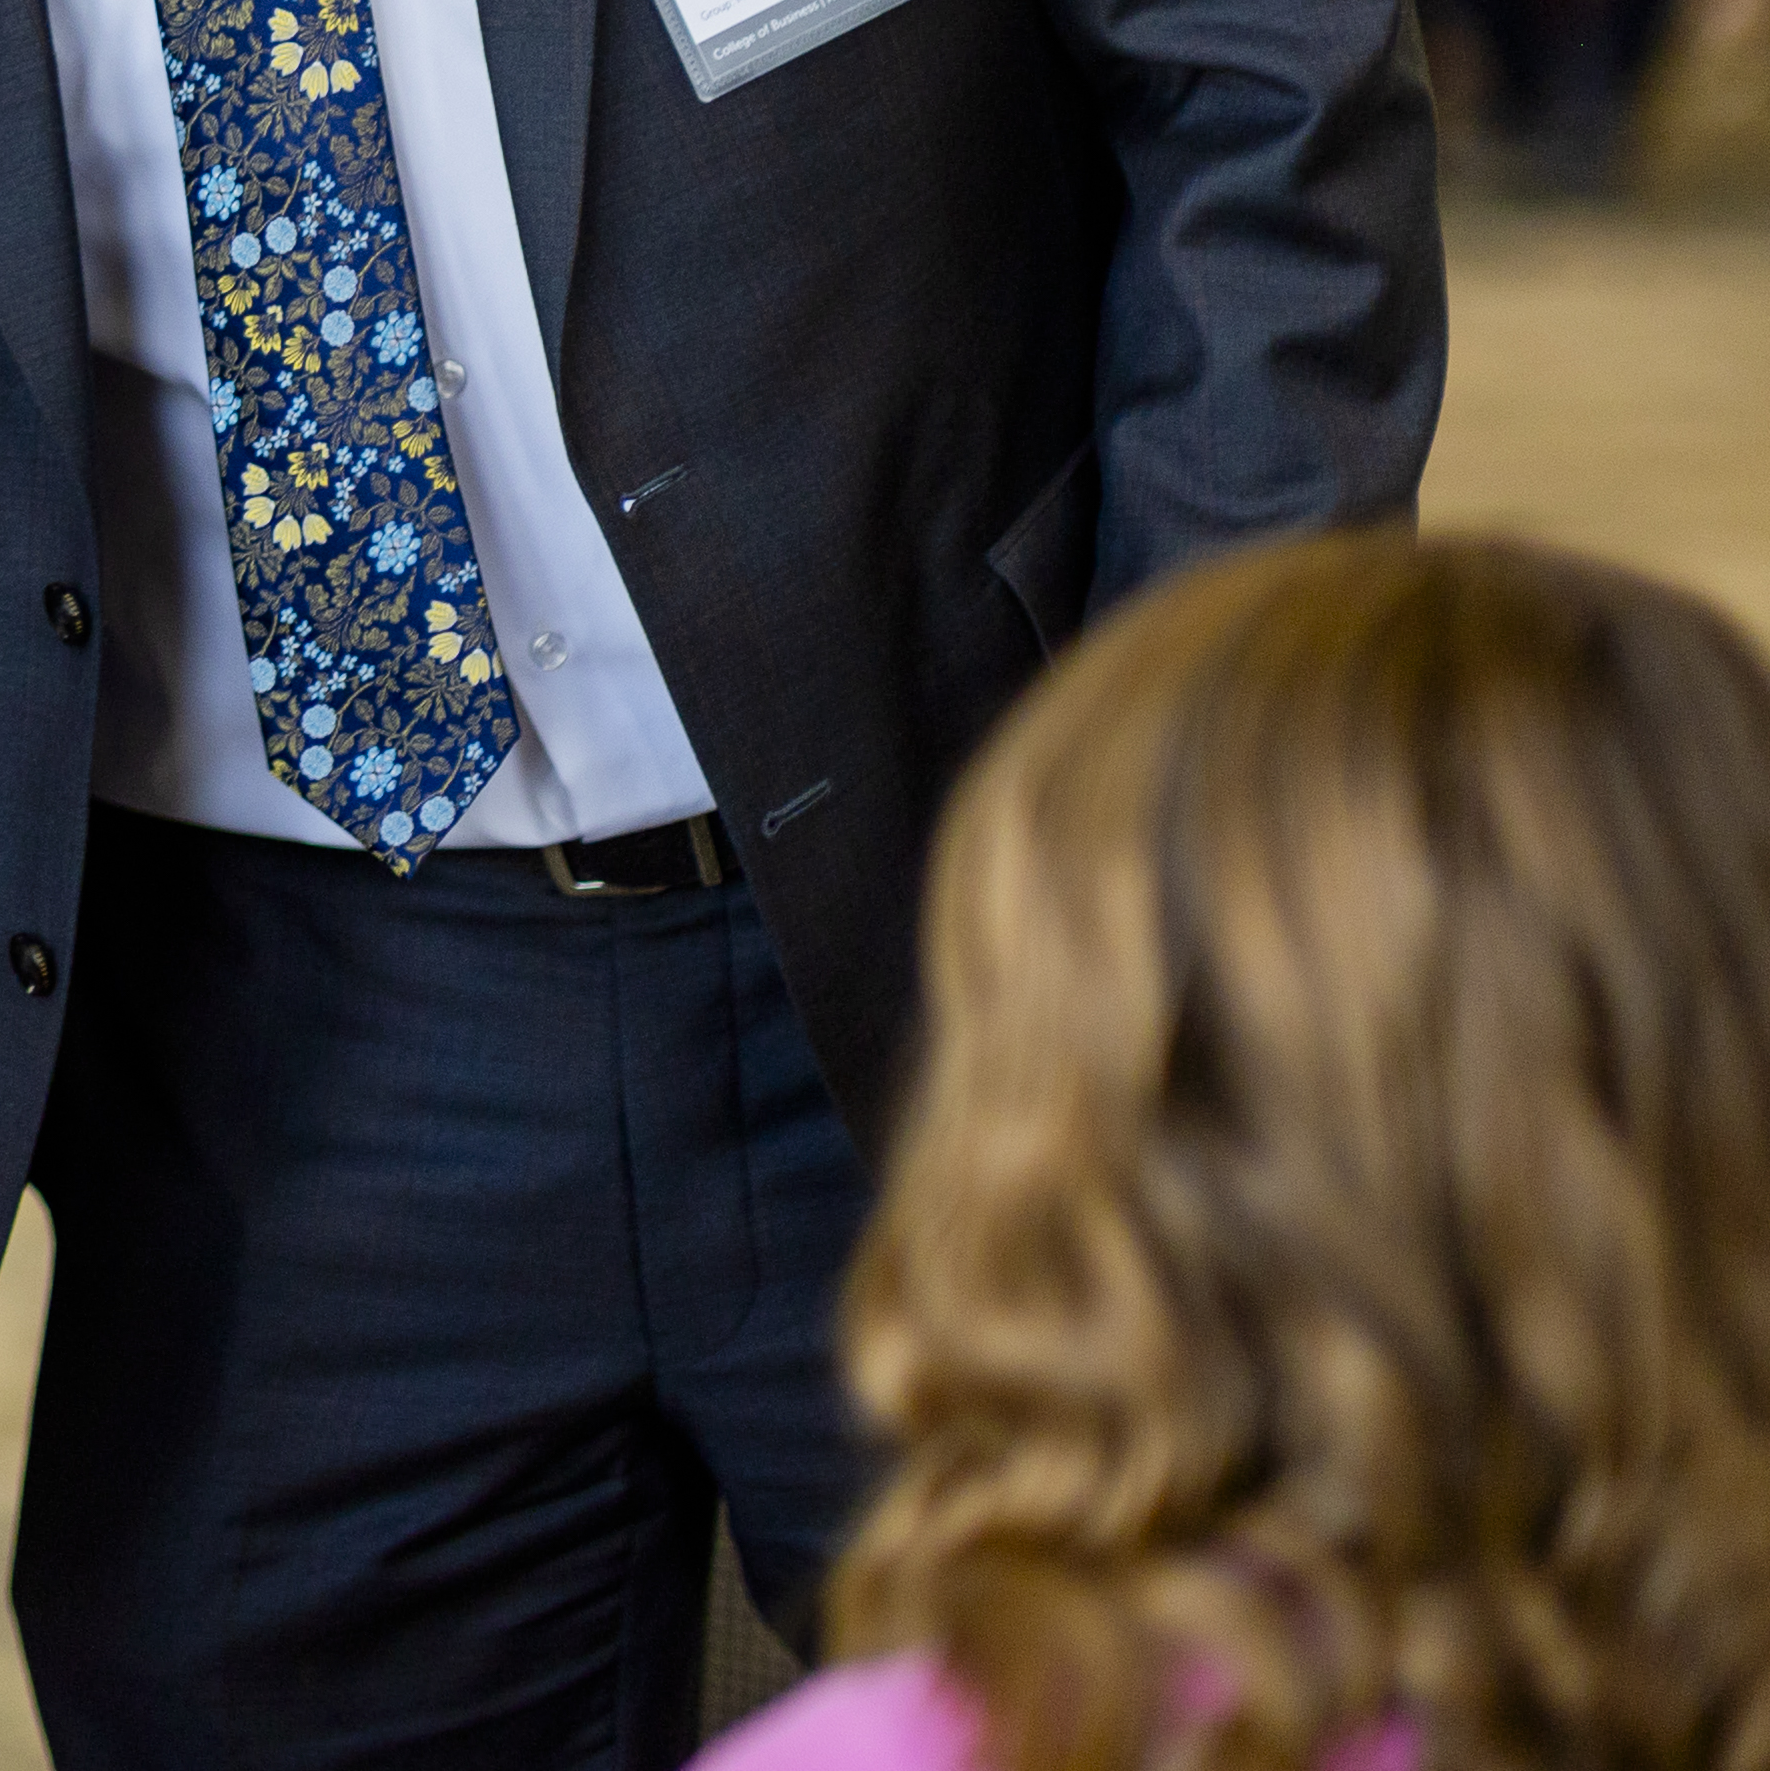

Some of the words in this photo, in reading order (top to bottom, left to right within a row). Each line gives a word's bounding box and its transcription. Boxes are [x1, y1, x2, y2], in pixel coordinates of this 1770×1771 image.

[713, 32, 757, 60] College
[757, 24, 771, 39] of
[770, 0, 821, 31] Business
